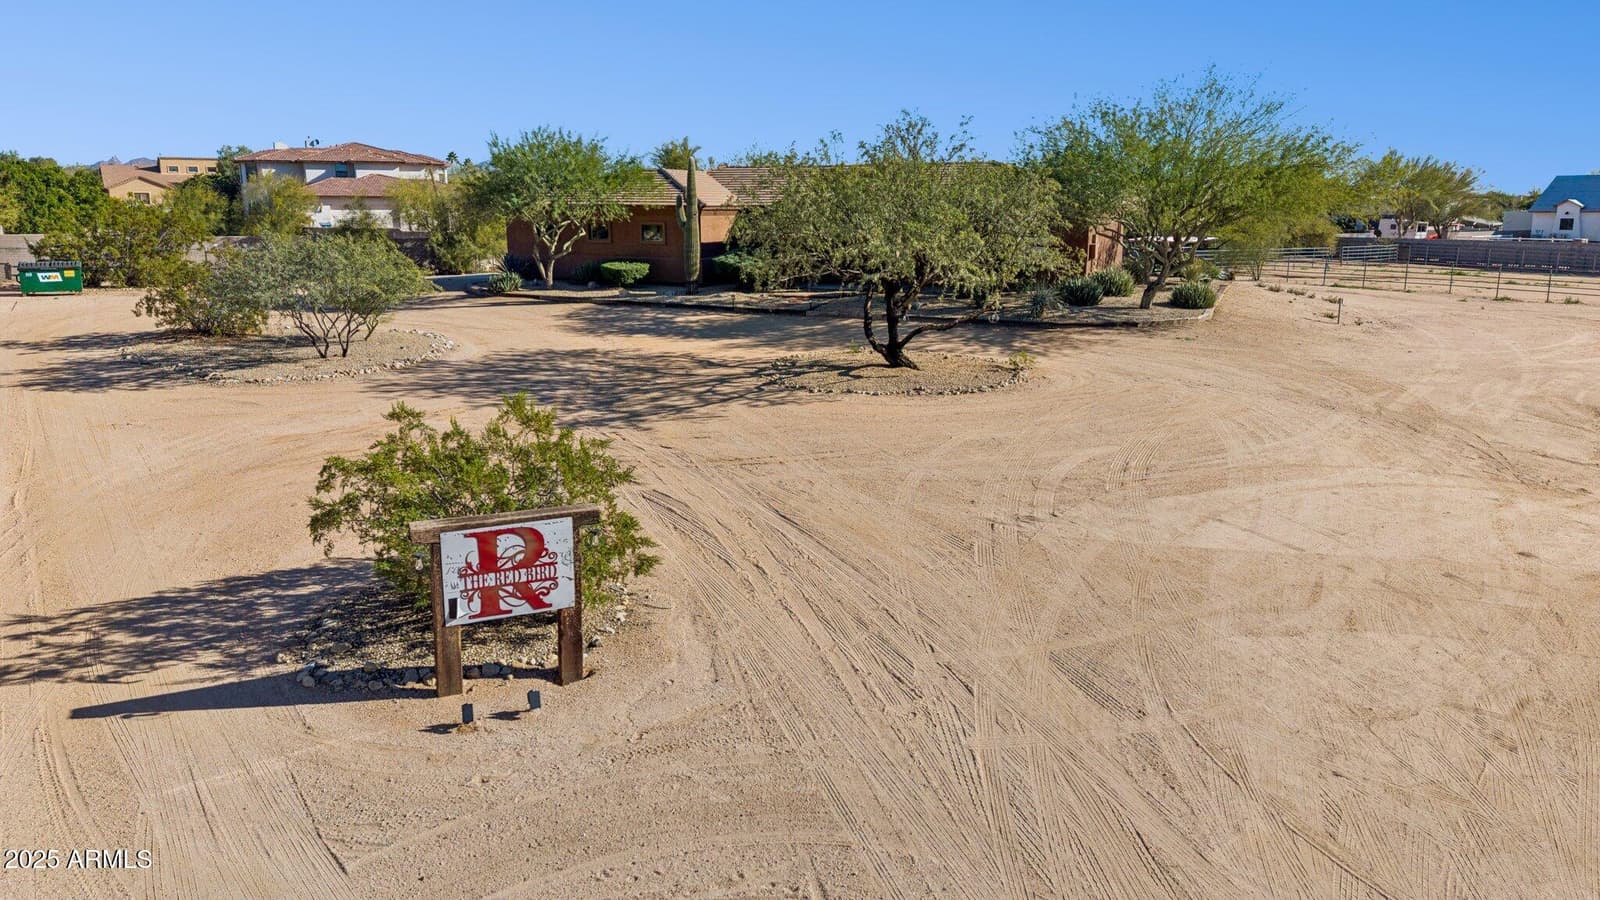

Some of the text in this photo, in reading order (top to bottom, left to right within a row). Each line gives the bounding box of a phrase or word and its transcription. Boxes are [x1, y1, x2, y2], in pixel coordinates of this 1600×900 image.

[463, 565, 557, 591] THE RED BIRD
[464, 527, 553, 620] R
